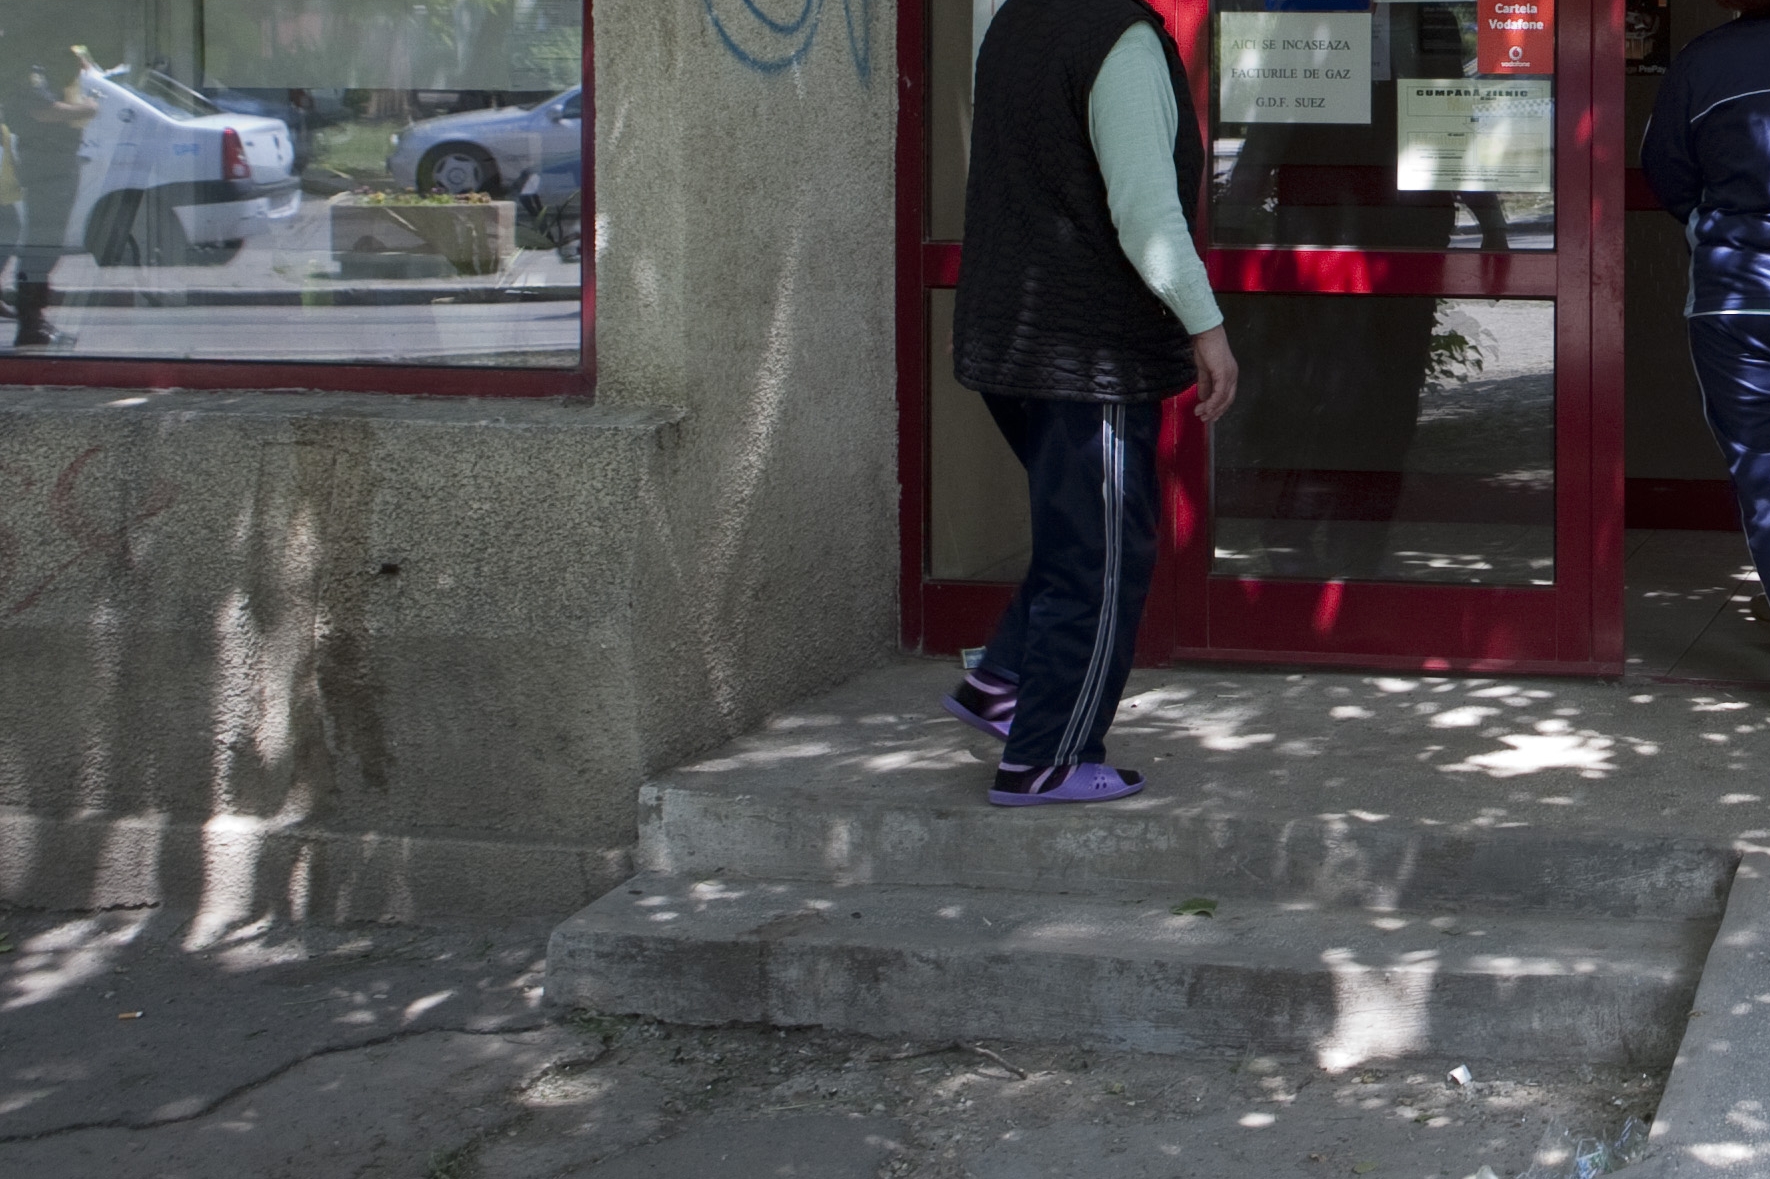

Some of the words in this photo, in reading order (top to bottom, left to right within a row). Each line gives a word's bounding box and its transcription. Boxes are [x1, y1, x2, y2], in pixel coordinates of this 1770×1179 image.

[1495, 2, 1538, 14] Cartela
[1489, 18, 1544, 30] Vodafone
[1232, 40, 1257, 51] AICI
[1262, 40, 1276, 50] SE
[1282, 40, 1351, 51] INCASEAZA
[1231, 68, 1298, 80] FACTURILE
[1303, 68, 1320, 79] DE
[1325, 68, 1351, 79] GAZ
[1416, 87, 1481, 97] CUMPĂRĂ
[1255, 97, 1289, 108] G.D.F.
[1295, 97, 1326, 108] SUEZ
